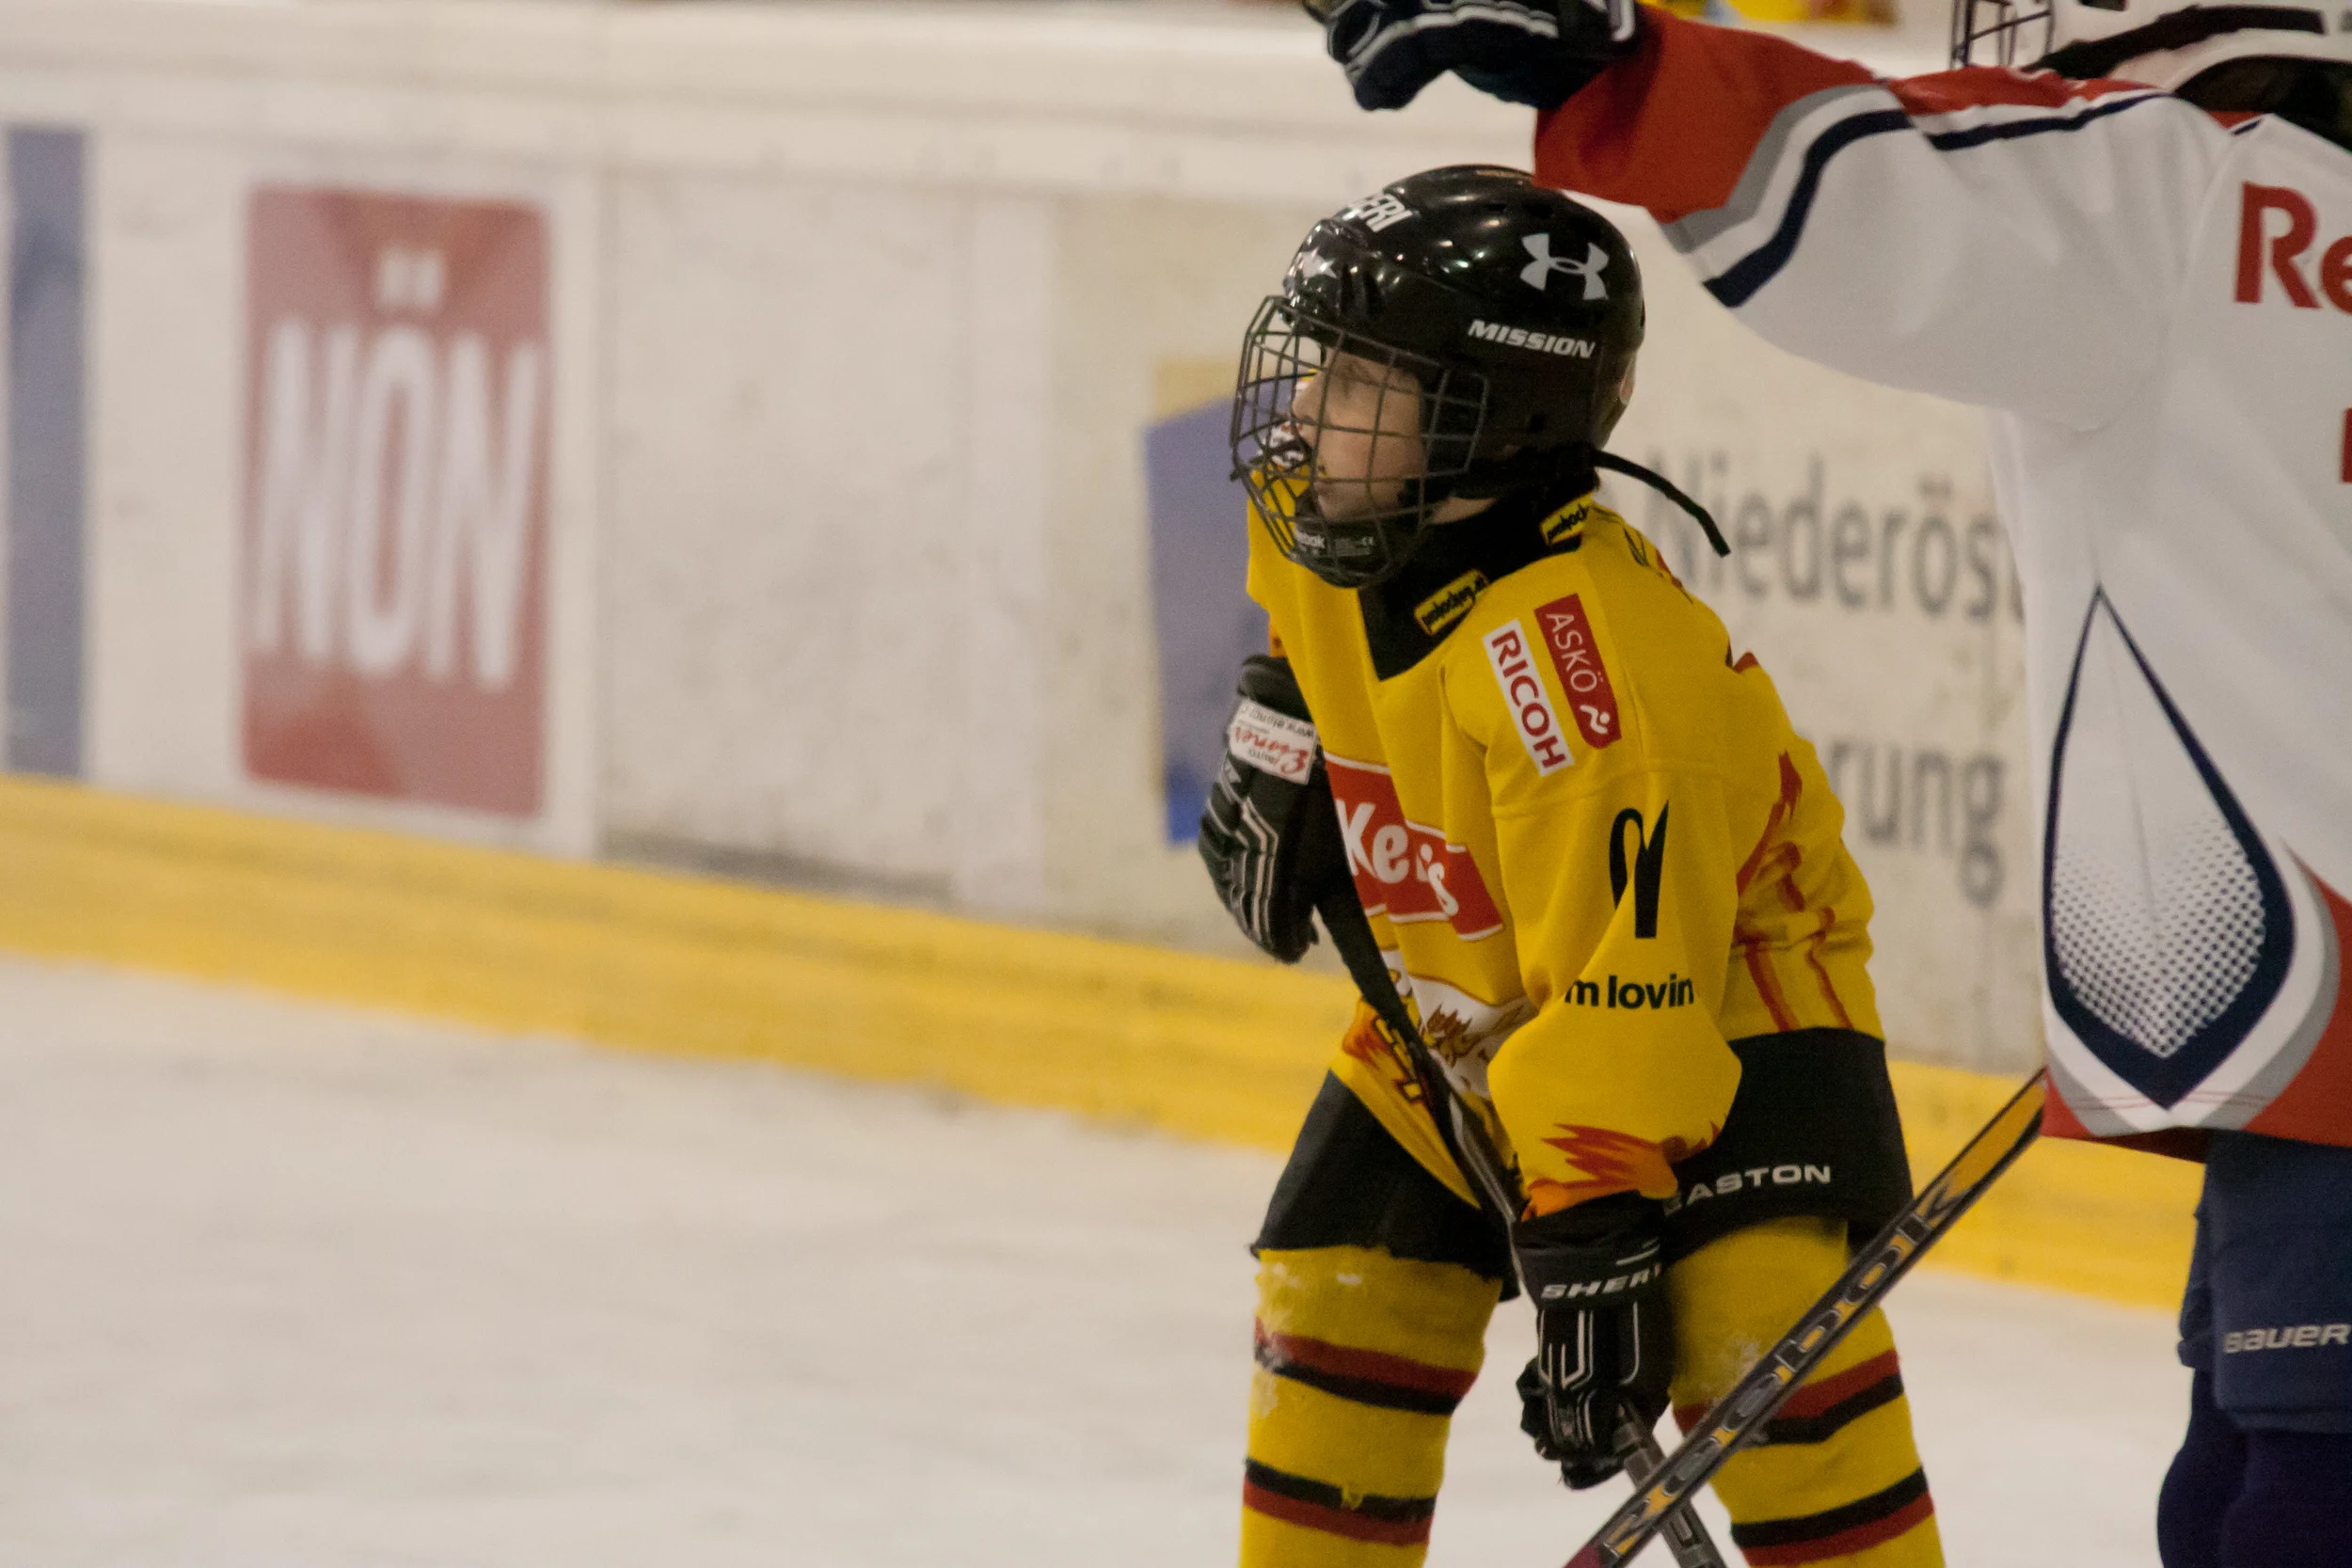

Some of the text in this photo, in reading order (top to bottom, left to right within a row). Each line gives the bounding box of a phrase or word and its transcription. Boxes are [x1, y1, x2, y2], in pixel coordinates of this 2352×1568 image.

[1468, 318, 1597, 358] MISSION
[252, 248, 546, 691] NÖN
[1546, 613, 1604, 693] ASKÖ
[1490, 628, 1566, 768] RICOH
[1830, 740, 2006, 909] rung
[1607, 973, 1694, 1009] lovin
[1663, 1165, 1831, 1217] EASTON
[1541, 1263, 1661, 1299] SHER
